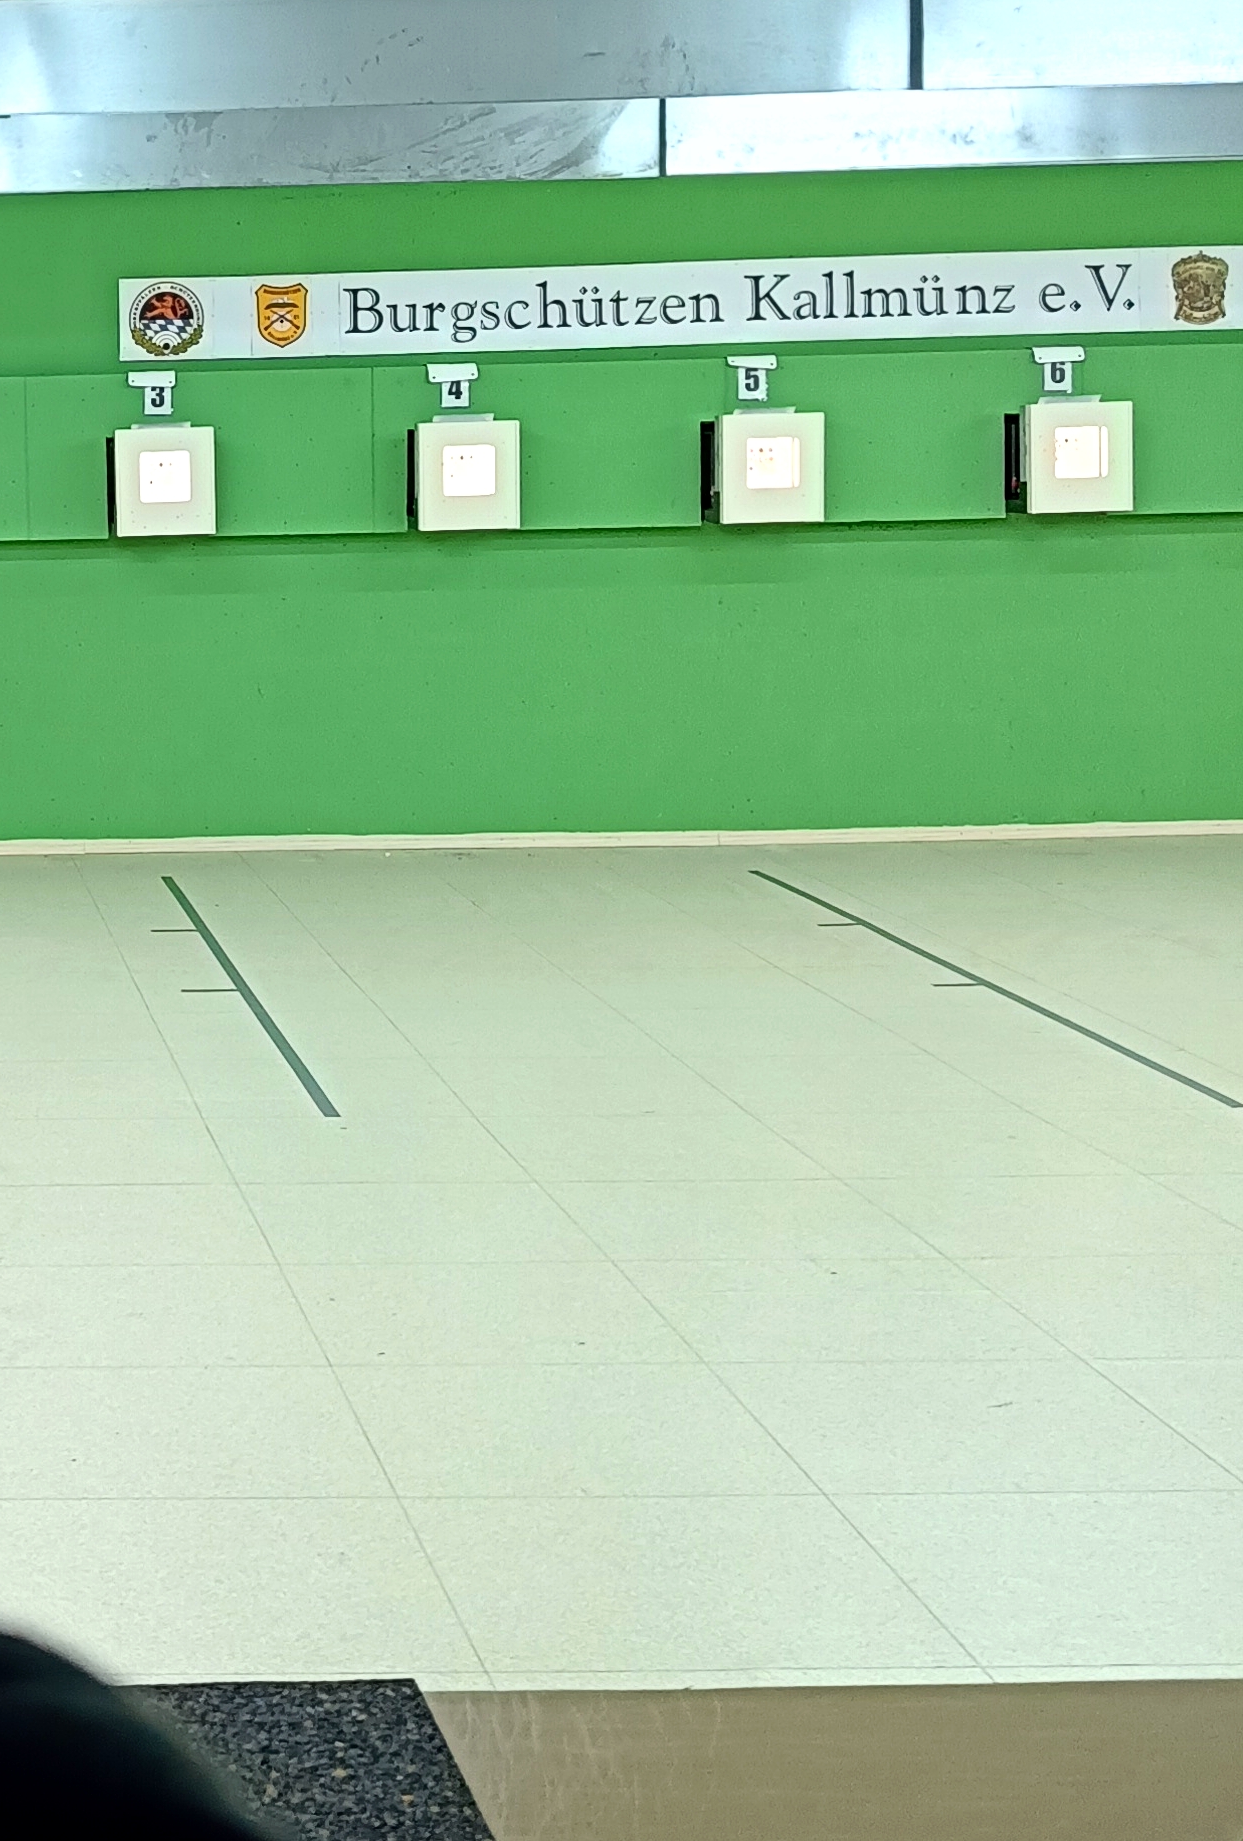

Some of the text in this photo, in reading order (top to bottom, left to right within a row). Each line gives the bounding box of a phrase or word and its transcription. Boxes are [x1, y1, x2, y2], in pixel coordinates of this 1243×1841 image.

[342, 263, 1135, 342] Burgschützen Kallmünz e.V.
[745, 367, 760, 392] 5
[1050, 361, 1066, 384] 6
[150, 386, 165, 408] 3
[448, 380, 463, 400] 4
